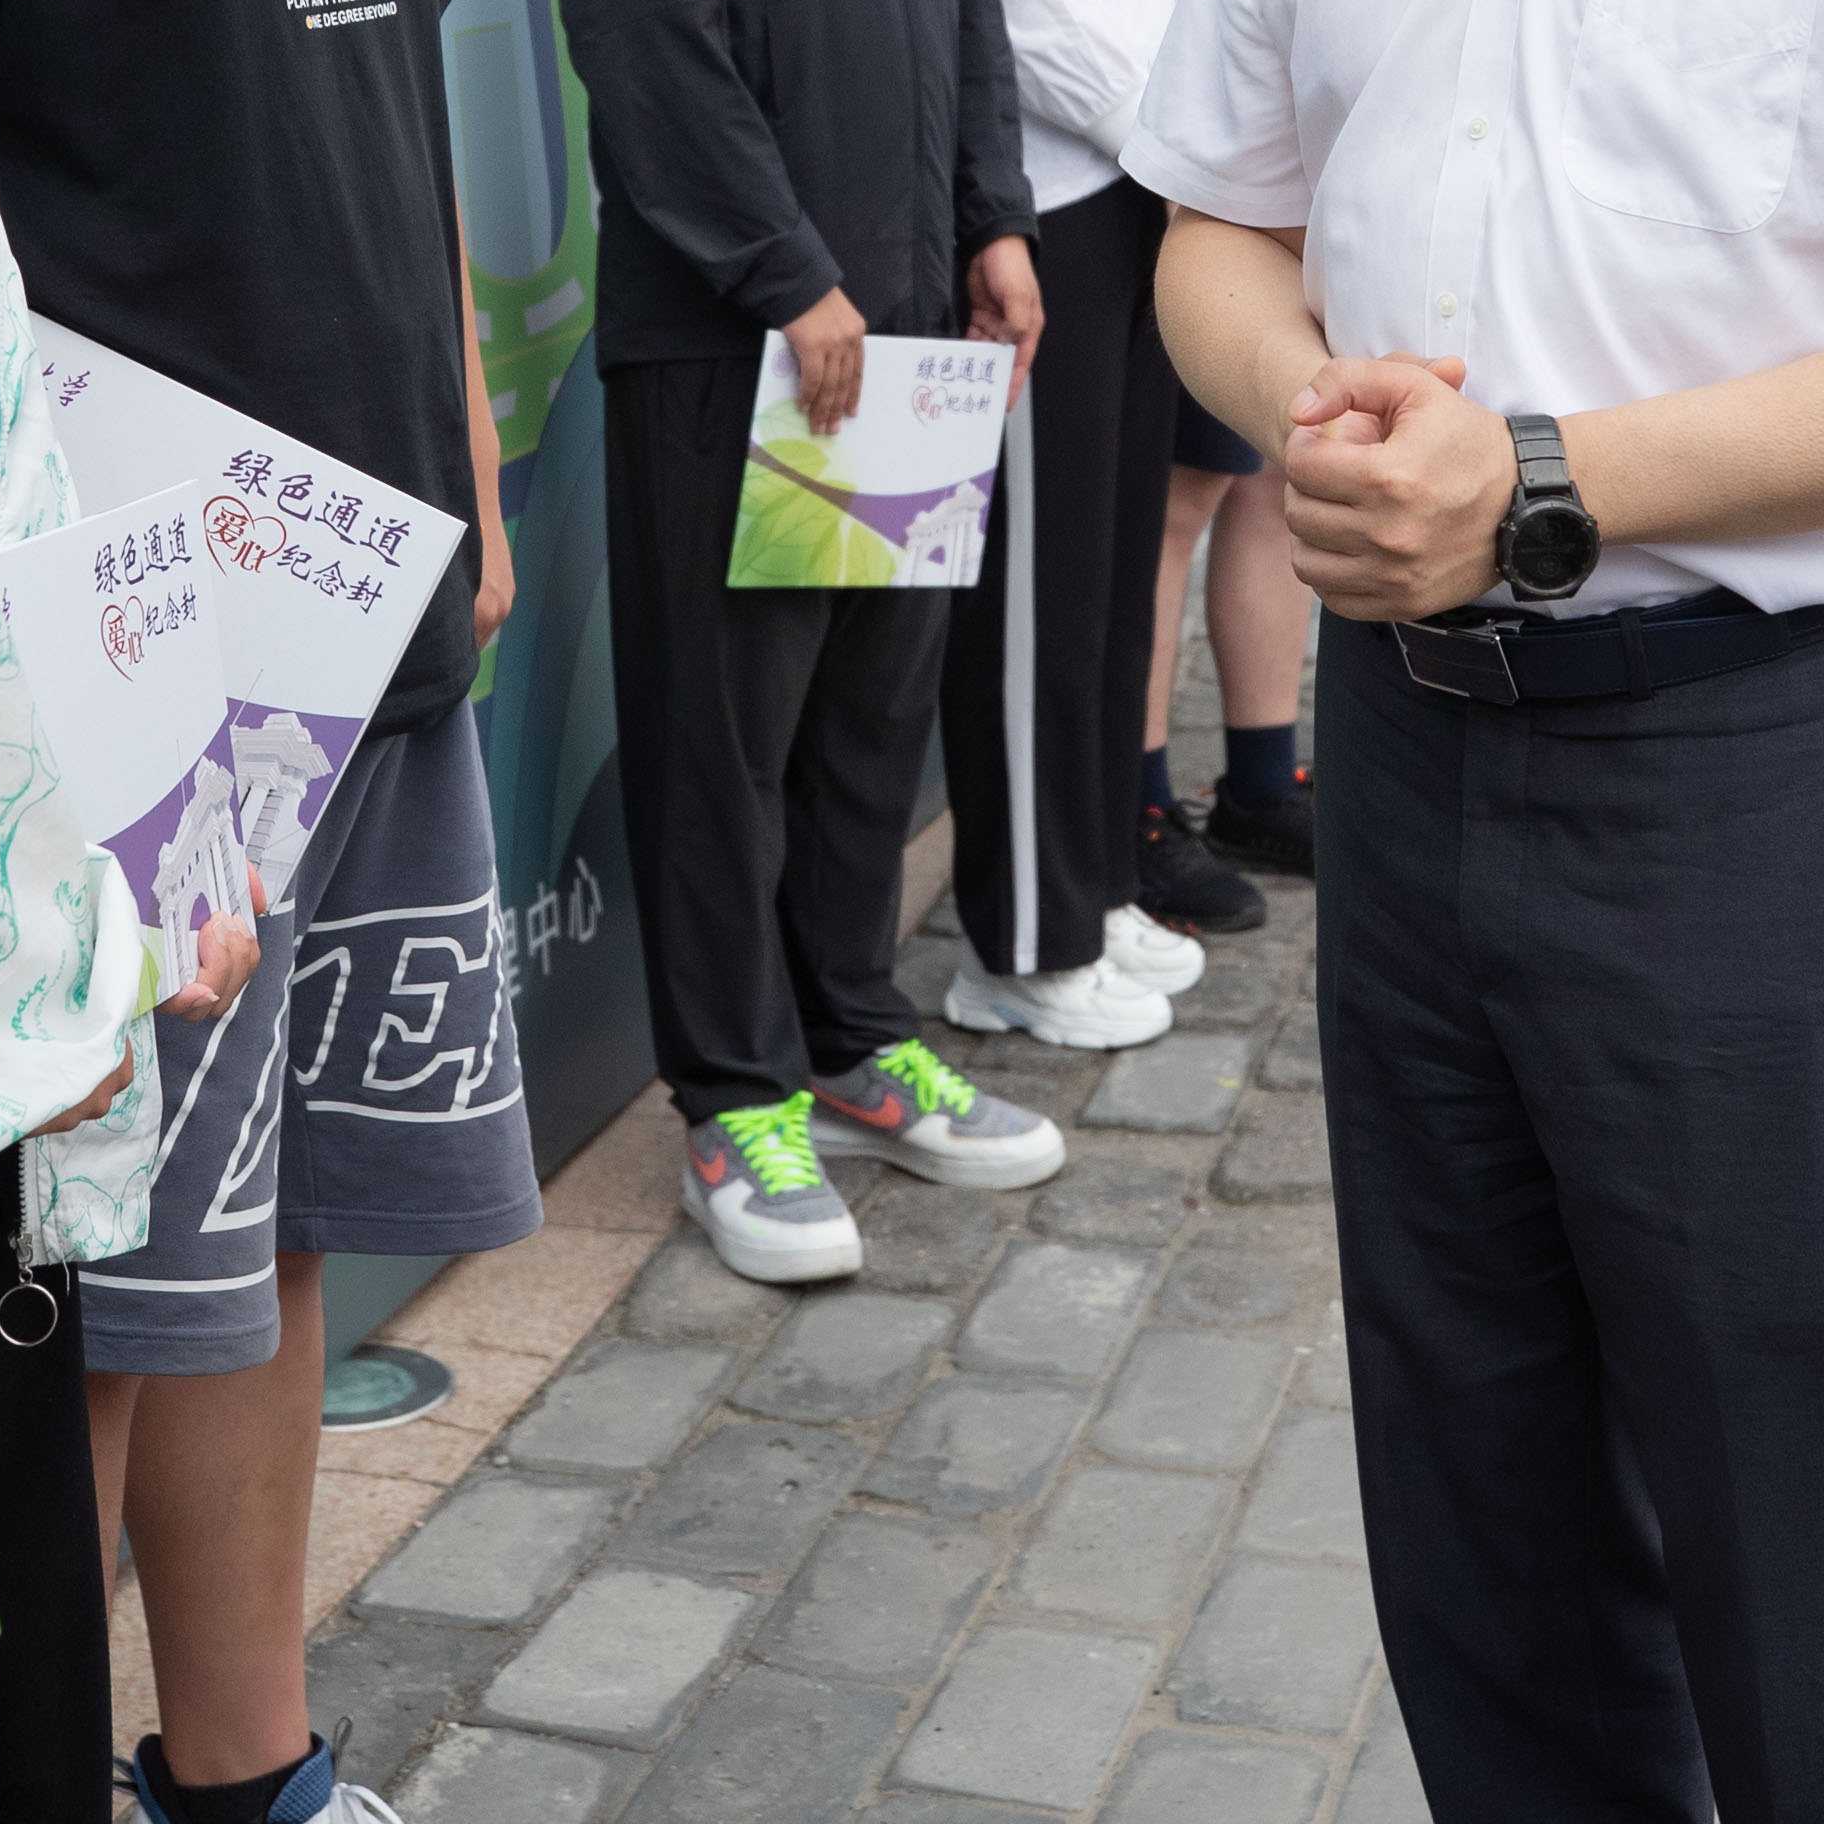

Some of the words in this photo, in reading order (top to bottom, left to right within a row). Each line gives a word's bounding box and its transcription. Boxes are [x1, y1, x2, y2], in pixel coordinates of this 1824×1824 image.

[323, 6, 365, 27] DEGREE
[222, 449, 411, 568] 绿色通道
[94, 512, 193, 594] 绿色通道
